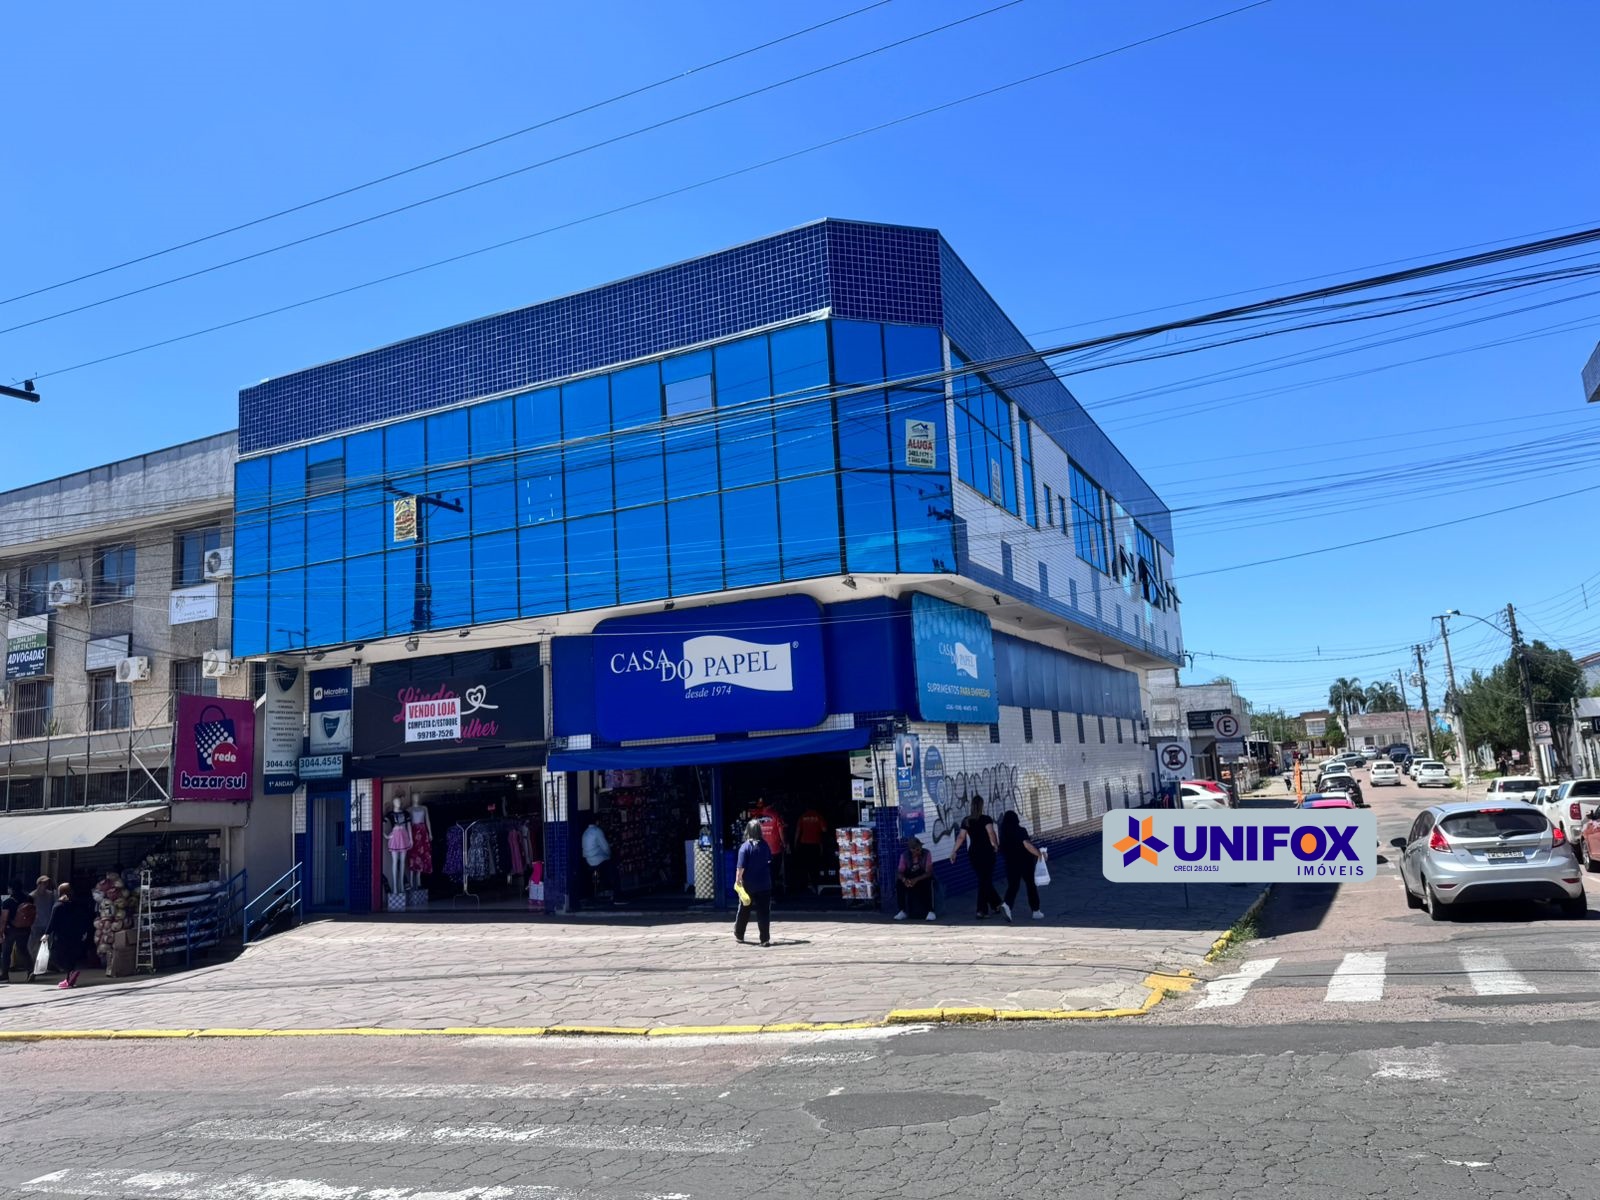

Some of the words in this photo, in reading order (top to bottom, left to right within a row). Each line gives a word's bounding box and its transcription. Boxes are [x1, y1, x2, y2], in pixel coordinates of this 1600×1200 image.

[908, 439, 933, 451] ALUGA
[7, 648, 46, 665] ADVOGADAS
[610, 648, 672, 674] CASA
[660, 659, 694, 682] DO
[704, 650, 778, 677] PAPEL
[323, 687, 349, 697] Microlins
[685, 686, 709, 699] desde
[711, 685, 732, 697] 1974
[408, 703, 435, 719] VENDO
[437, 701, 456, 716] LOJA
[407, 719, 431, 730] COMPLETA
[1223, 720, 1232, 733] E
[416, 729, 454, 740] 99718-7526
[214, 751, 237, 763] rede
[300, 756, 342, 768] 3044.4545
[265, 760, 300, 768] 3044.454
[180, 770, 225, 789] bazar
[225, 772, 247, 789] sul
